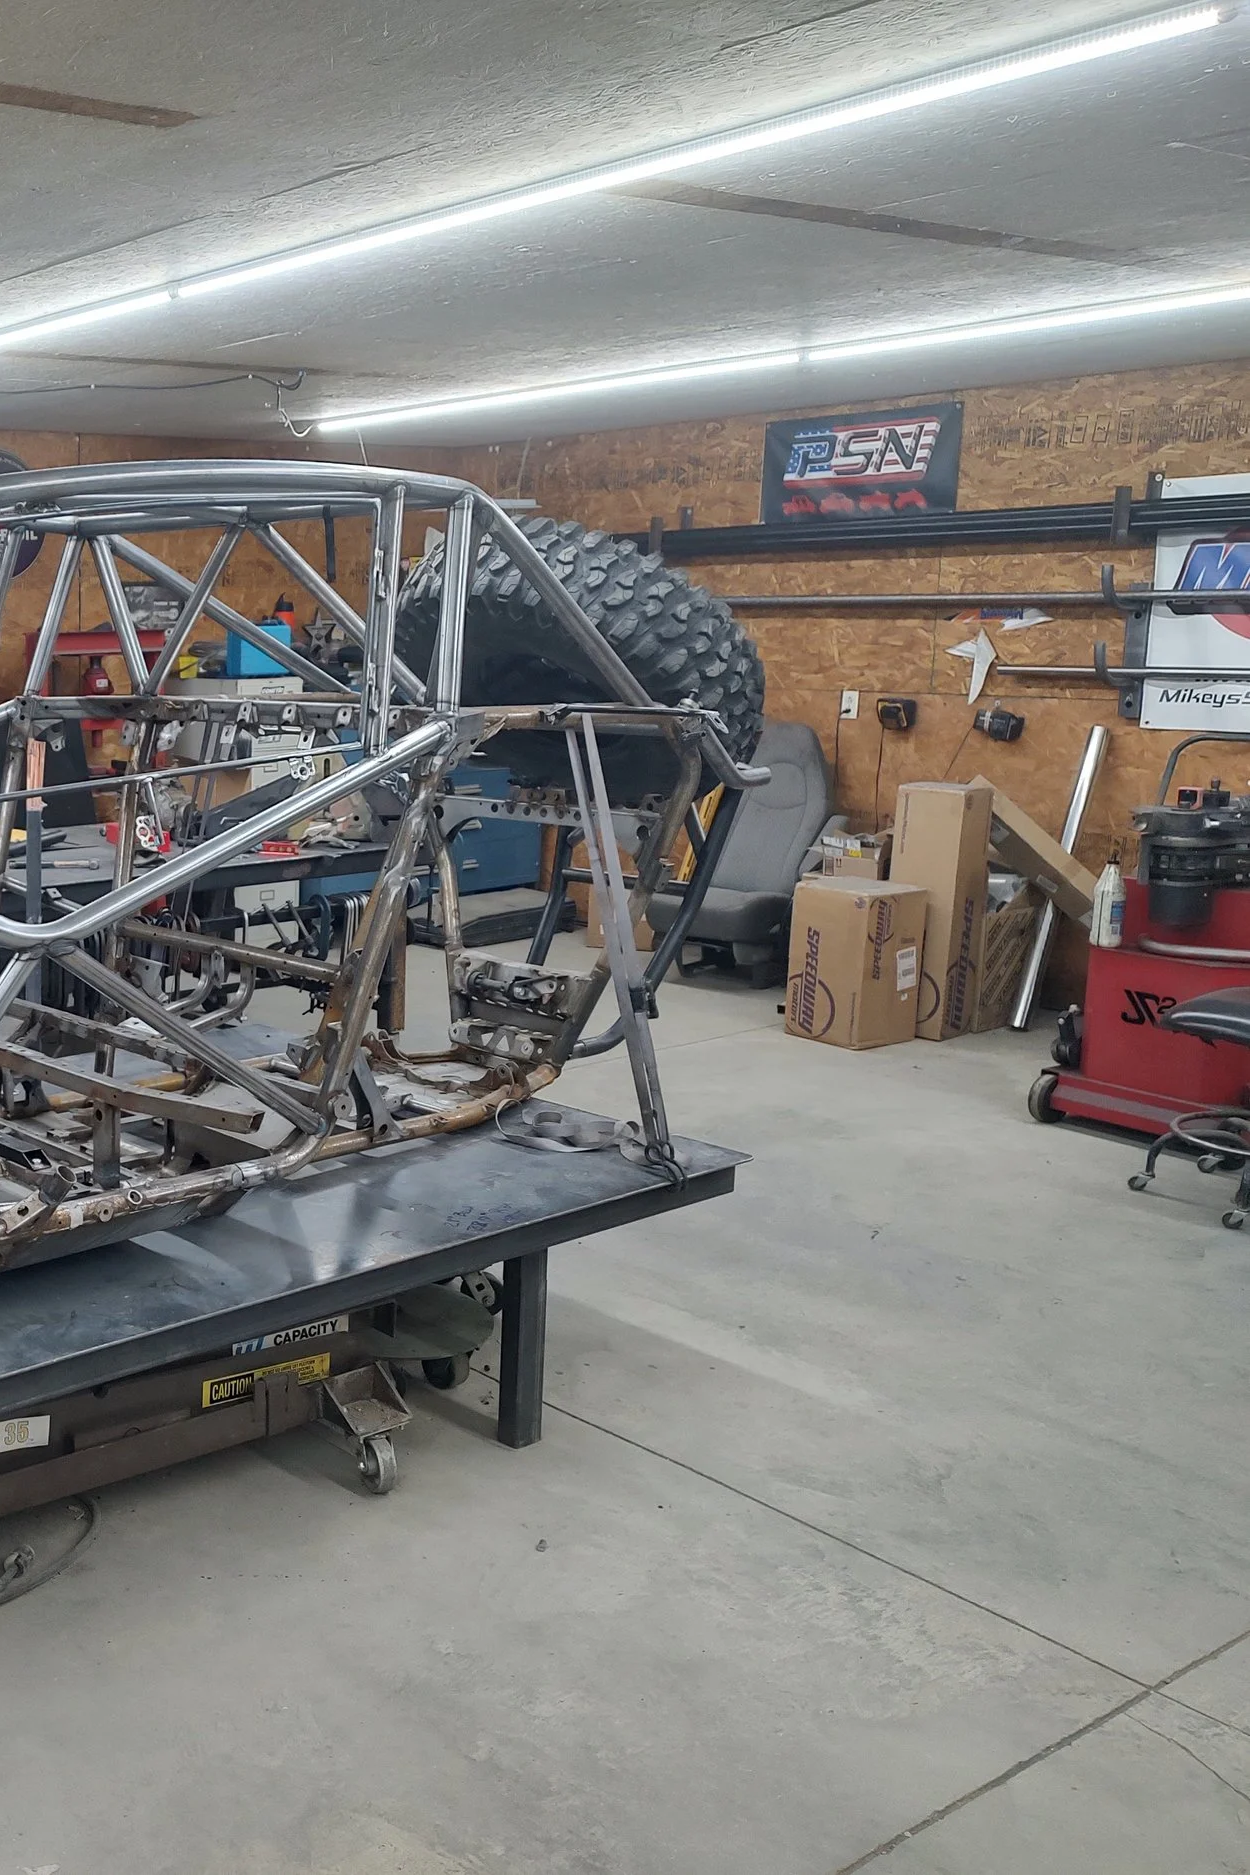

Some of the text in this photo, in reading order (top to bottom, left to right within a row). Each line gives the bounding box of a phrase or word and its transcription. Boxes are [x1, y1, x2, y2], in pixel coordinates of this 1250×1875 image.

[792, 424, 925, 478] PSN
[799, 926, 821, 1035] SPEEDWAY
[273, 1319, 339, 1346] CAPACITY
[4, 1420, 29, 1446] 35
